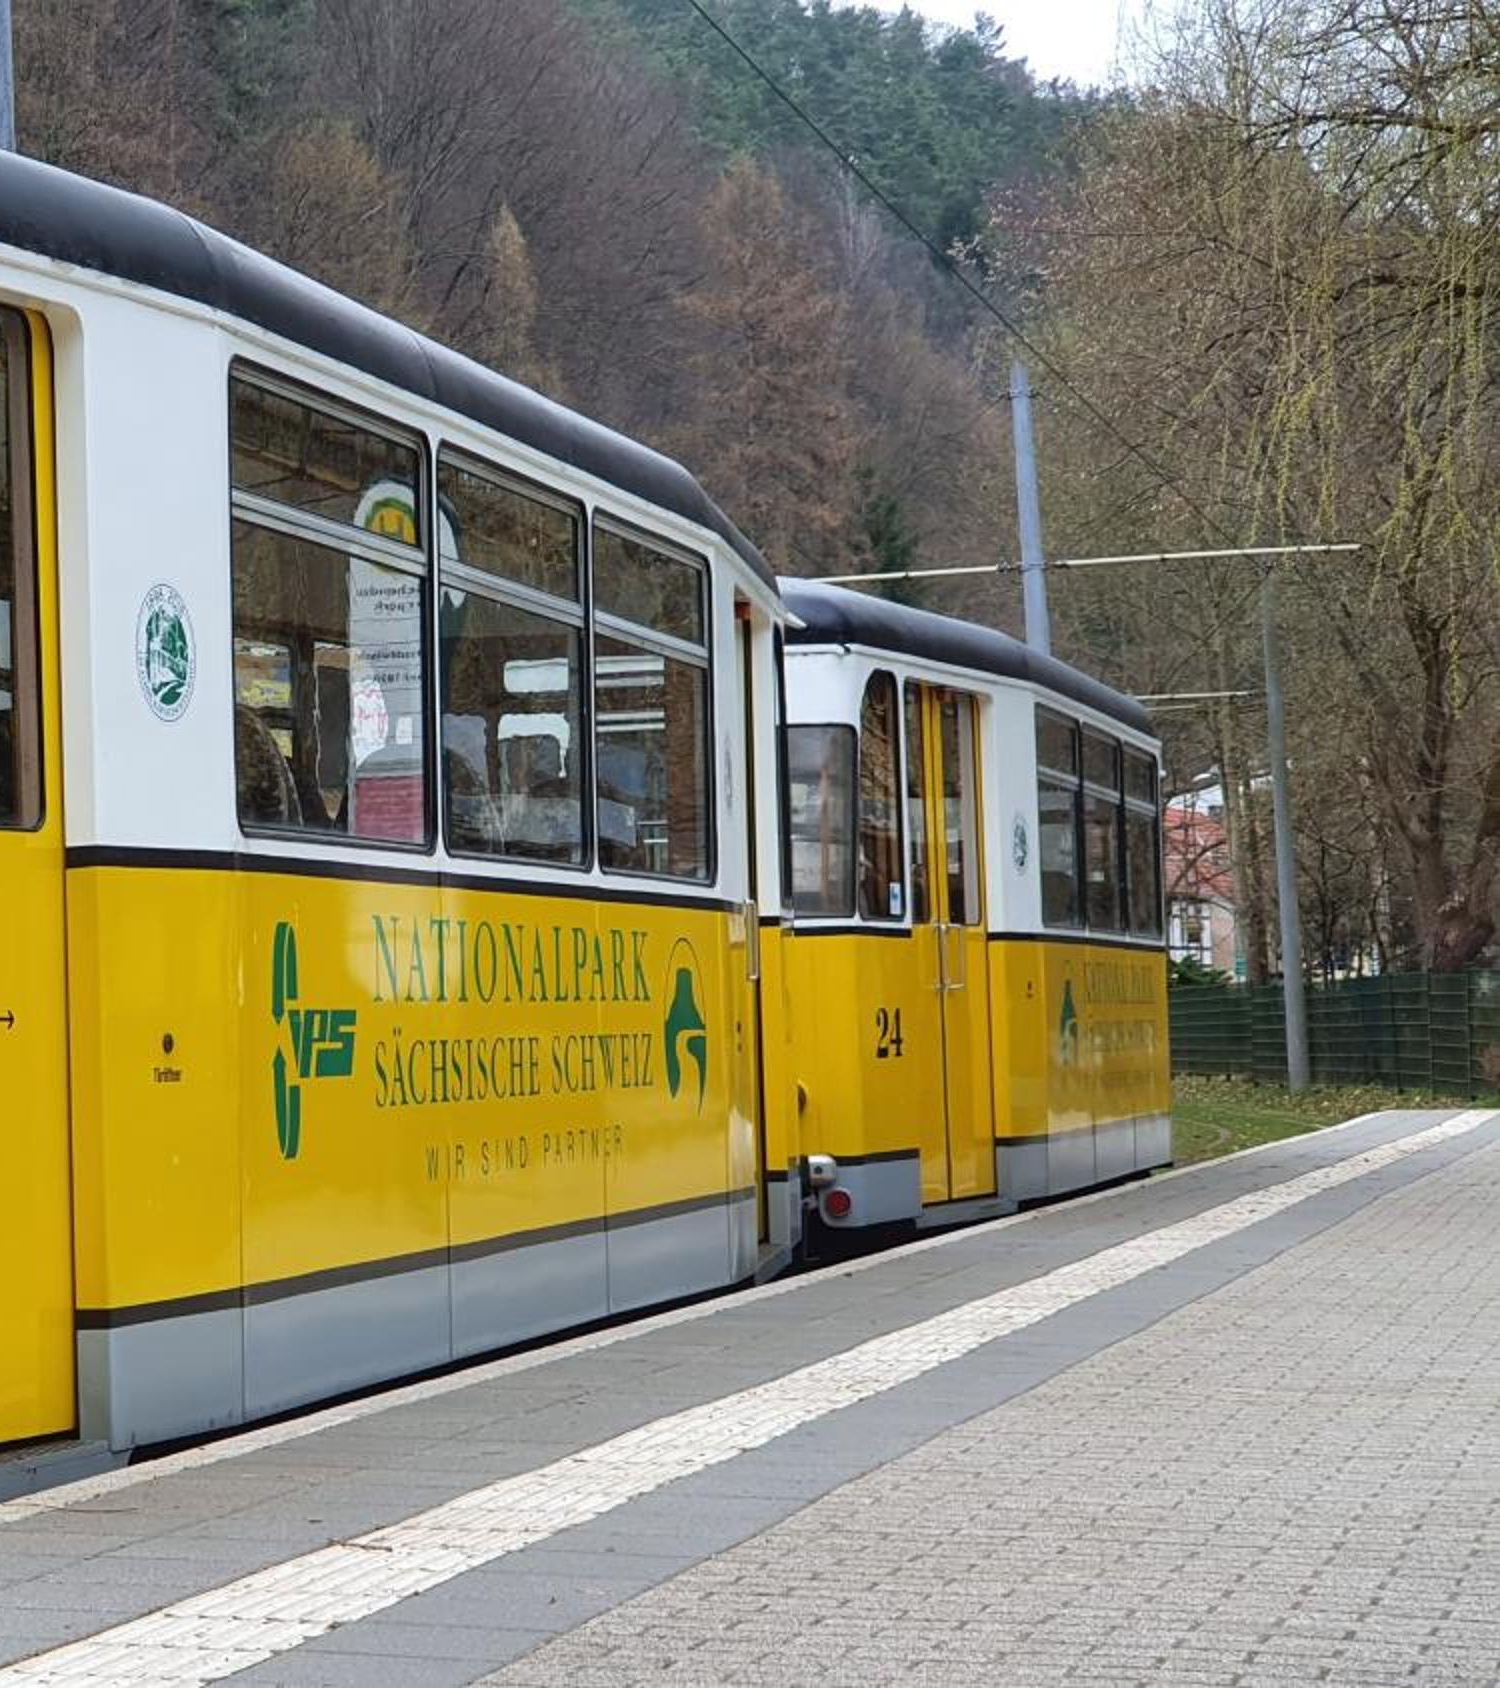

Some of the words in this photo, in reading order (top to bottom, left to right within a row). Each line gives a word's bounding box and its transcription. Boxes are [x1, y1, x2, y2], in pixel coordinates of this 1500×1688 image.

[372, 914, 651, 1003] NATIONALPARK
[374, 1026, 541, 1108] SÄCHSISCHE
[551, 1033, 653, 1094] SCHWEIZ
[876, 1007, 903, 1058] 24
[426, 1143, 465, 1181] WIR
[481, 1135, 529, 1176] SIND
[543, 1124, 623, 1168] PARTNER
